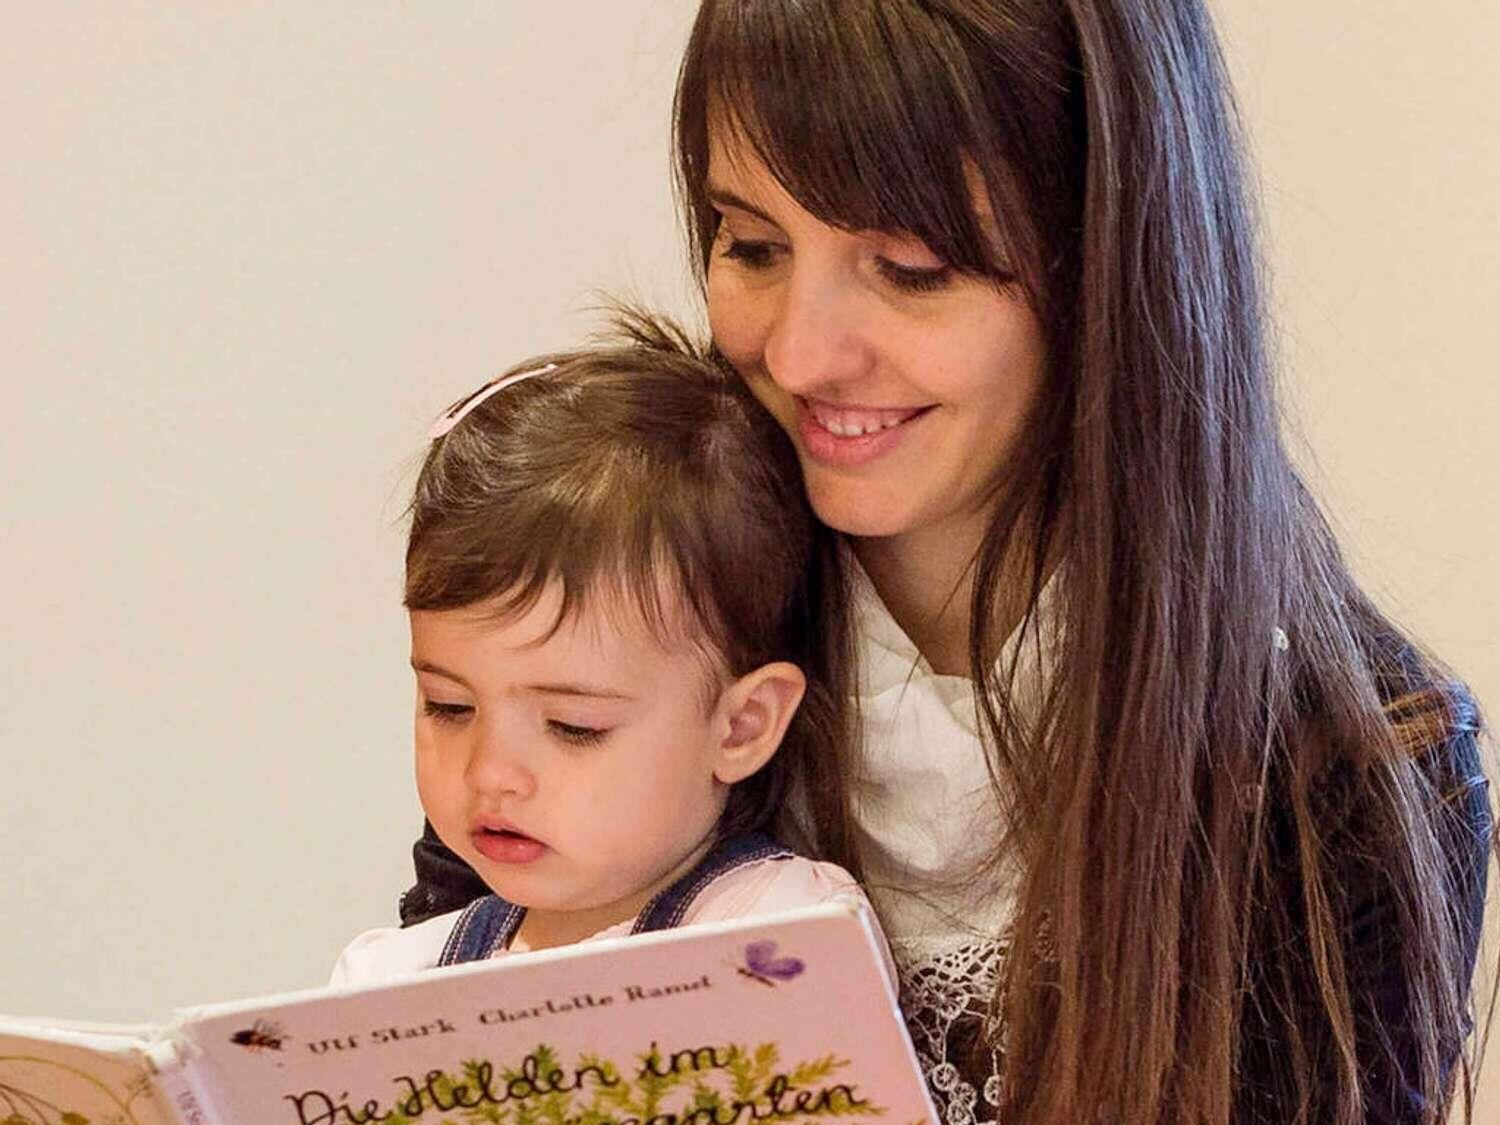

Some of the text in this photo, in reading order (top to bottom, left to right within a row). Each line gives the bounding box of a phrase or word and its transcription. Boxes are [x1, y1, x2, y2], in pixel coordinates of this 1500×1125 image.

[308, 1035, 358, 1055] Ulf
[371, 1018, 457, 1044] Stark
[479, 993, 613, 1025] Charlotte
[393, 1055, 620, 1118] Helden
[639, 1041, 731, 1081] im
